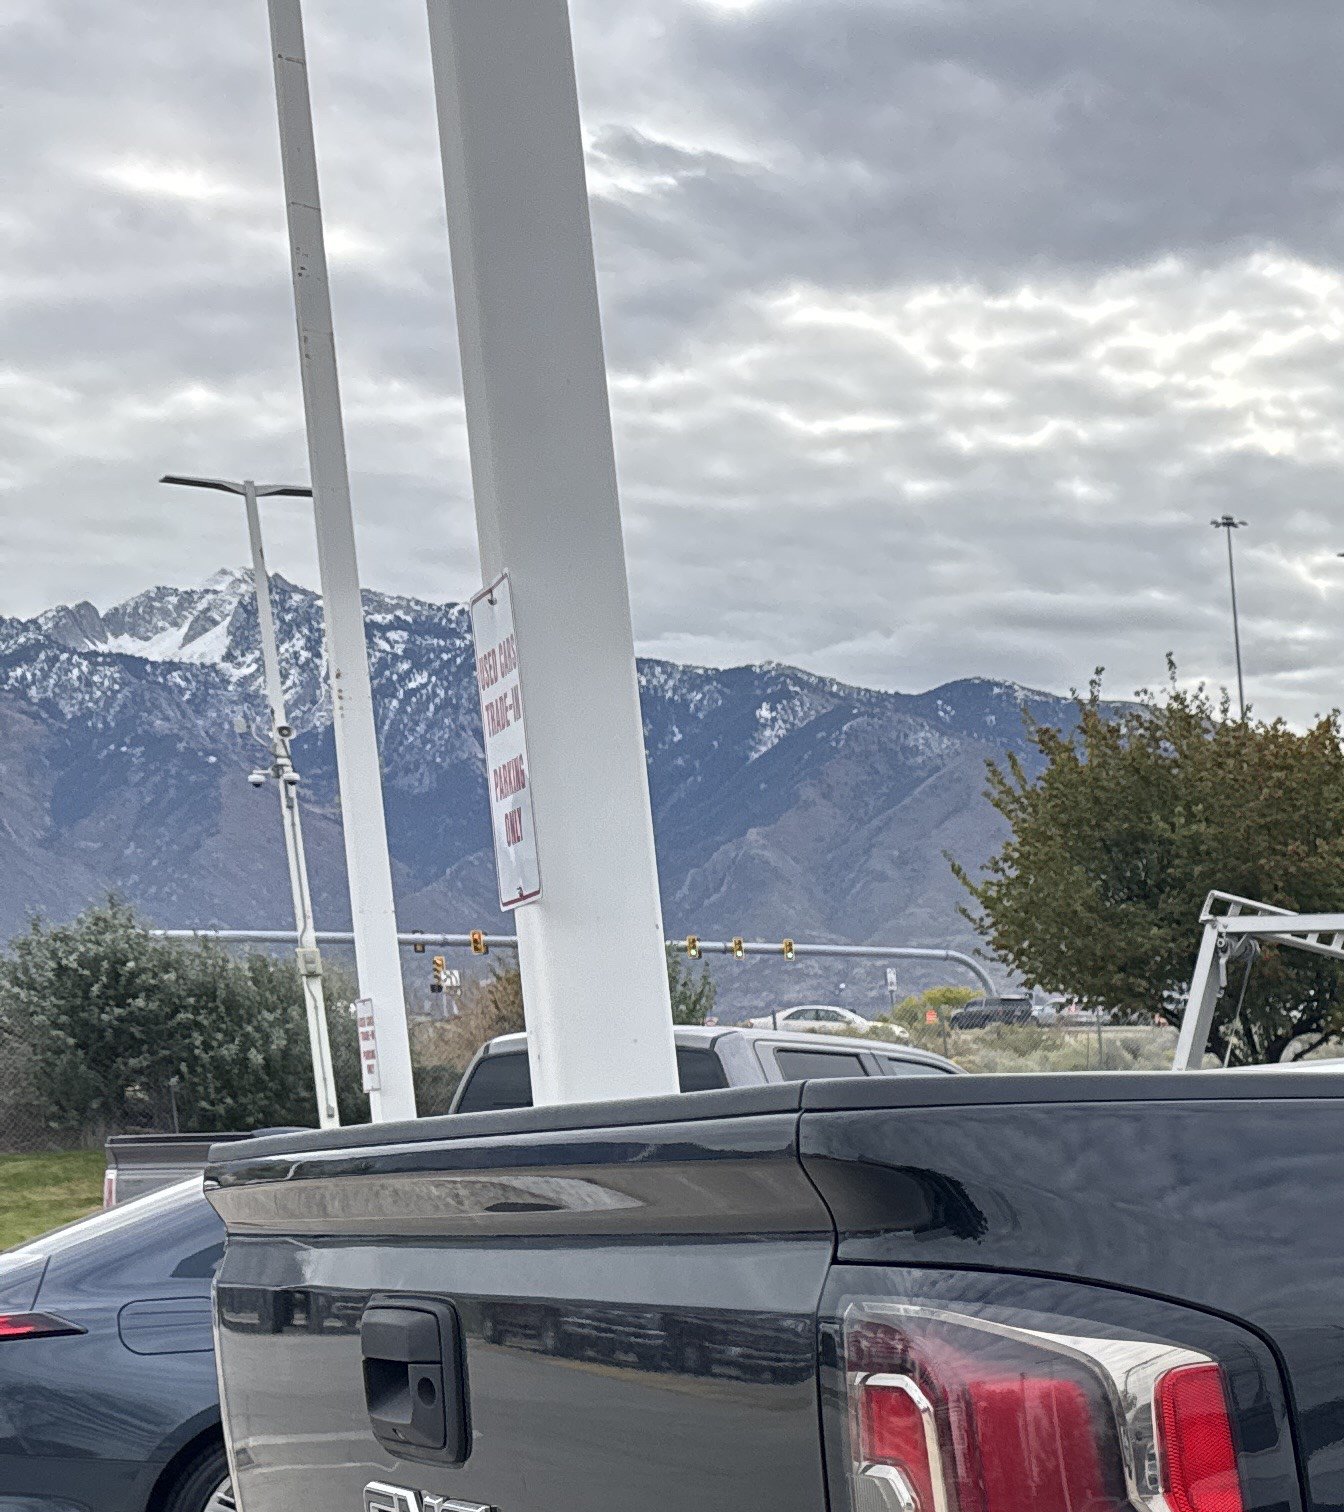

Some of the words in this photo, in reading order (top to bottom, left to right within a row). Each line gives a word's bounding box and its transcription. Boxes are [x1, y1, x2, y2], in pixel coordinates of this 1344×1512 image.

[479, 648, 498, 691] USED
[499, 633, 517, 679] CARS
[485, 684, 522, 738] TRADE-IN
[493, 753, 526, 803] PARKING
[504, 806, 524, 847] ONLY
